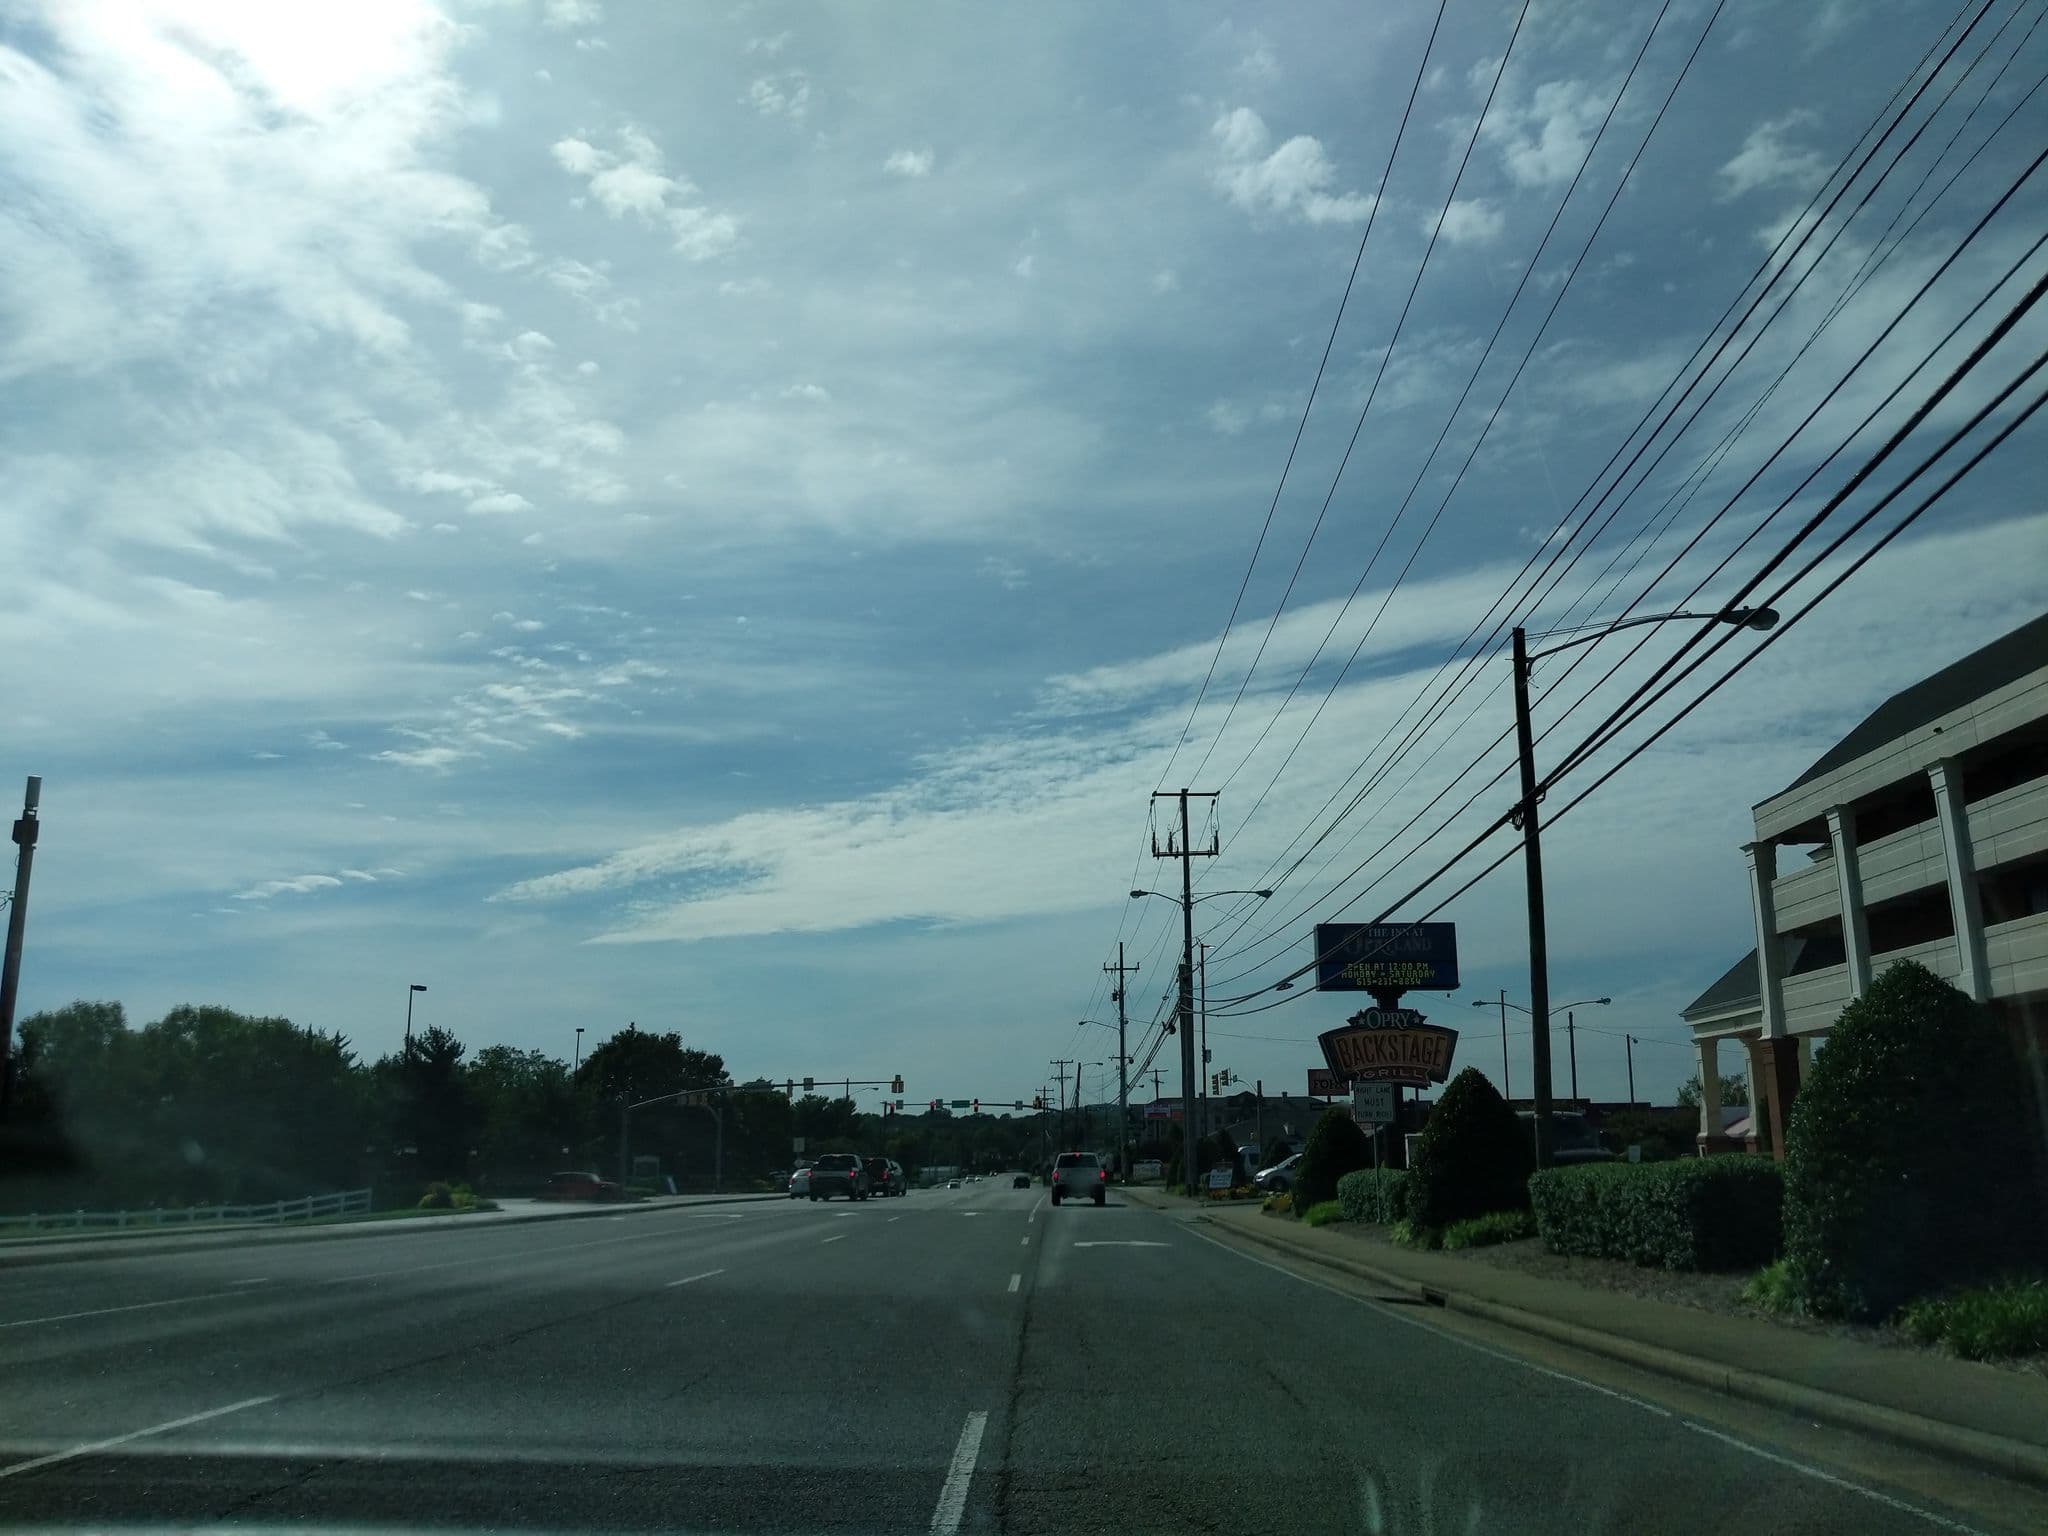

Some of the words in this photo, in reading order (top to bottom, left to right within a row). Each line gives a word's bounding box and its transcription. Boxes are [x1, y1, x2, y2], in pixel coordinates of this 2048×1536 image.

[1374, 963, 1385, 971] AT
[1416, 963, 1429, 971] PM
[1341, 970, 1376, 979] MONDAY
[1390, 970, 1436, 979] SATURDAY
[1366, 1009, 1411, 1031] OPRY
[1336, 1034, 1446, 1068] BACKSTAGE
[1362, 1069, 1424, 1079] GRILL
[1363, 1097, 1384, 1106] MUST
